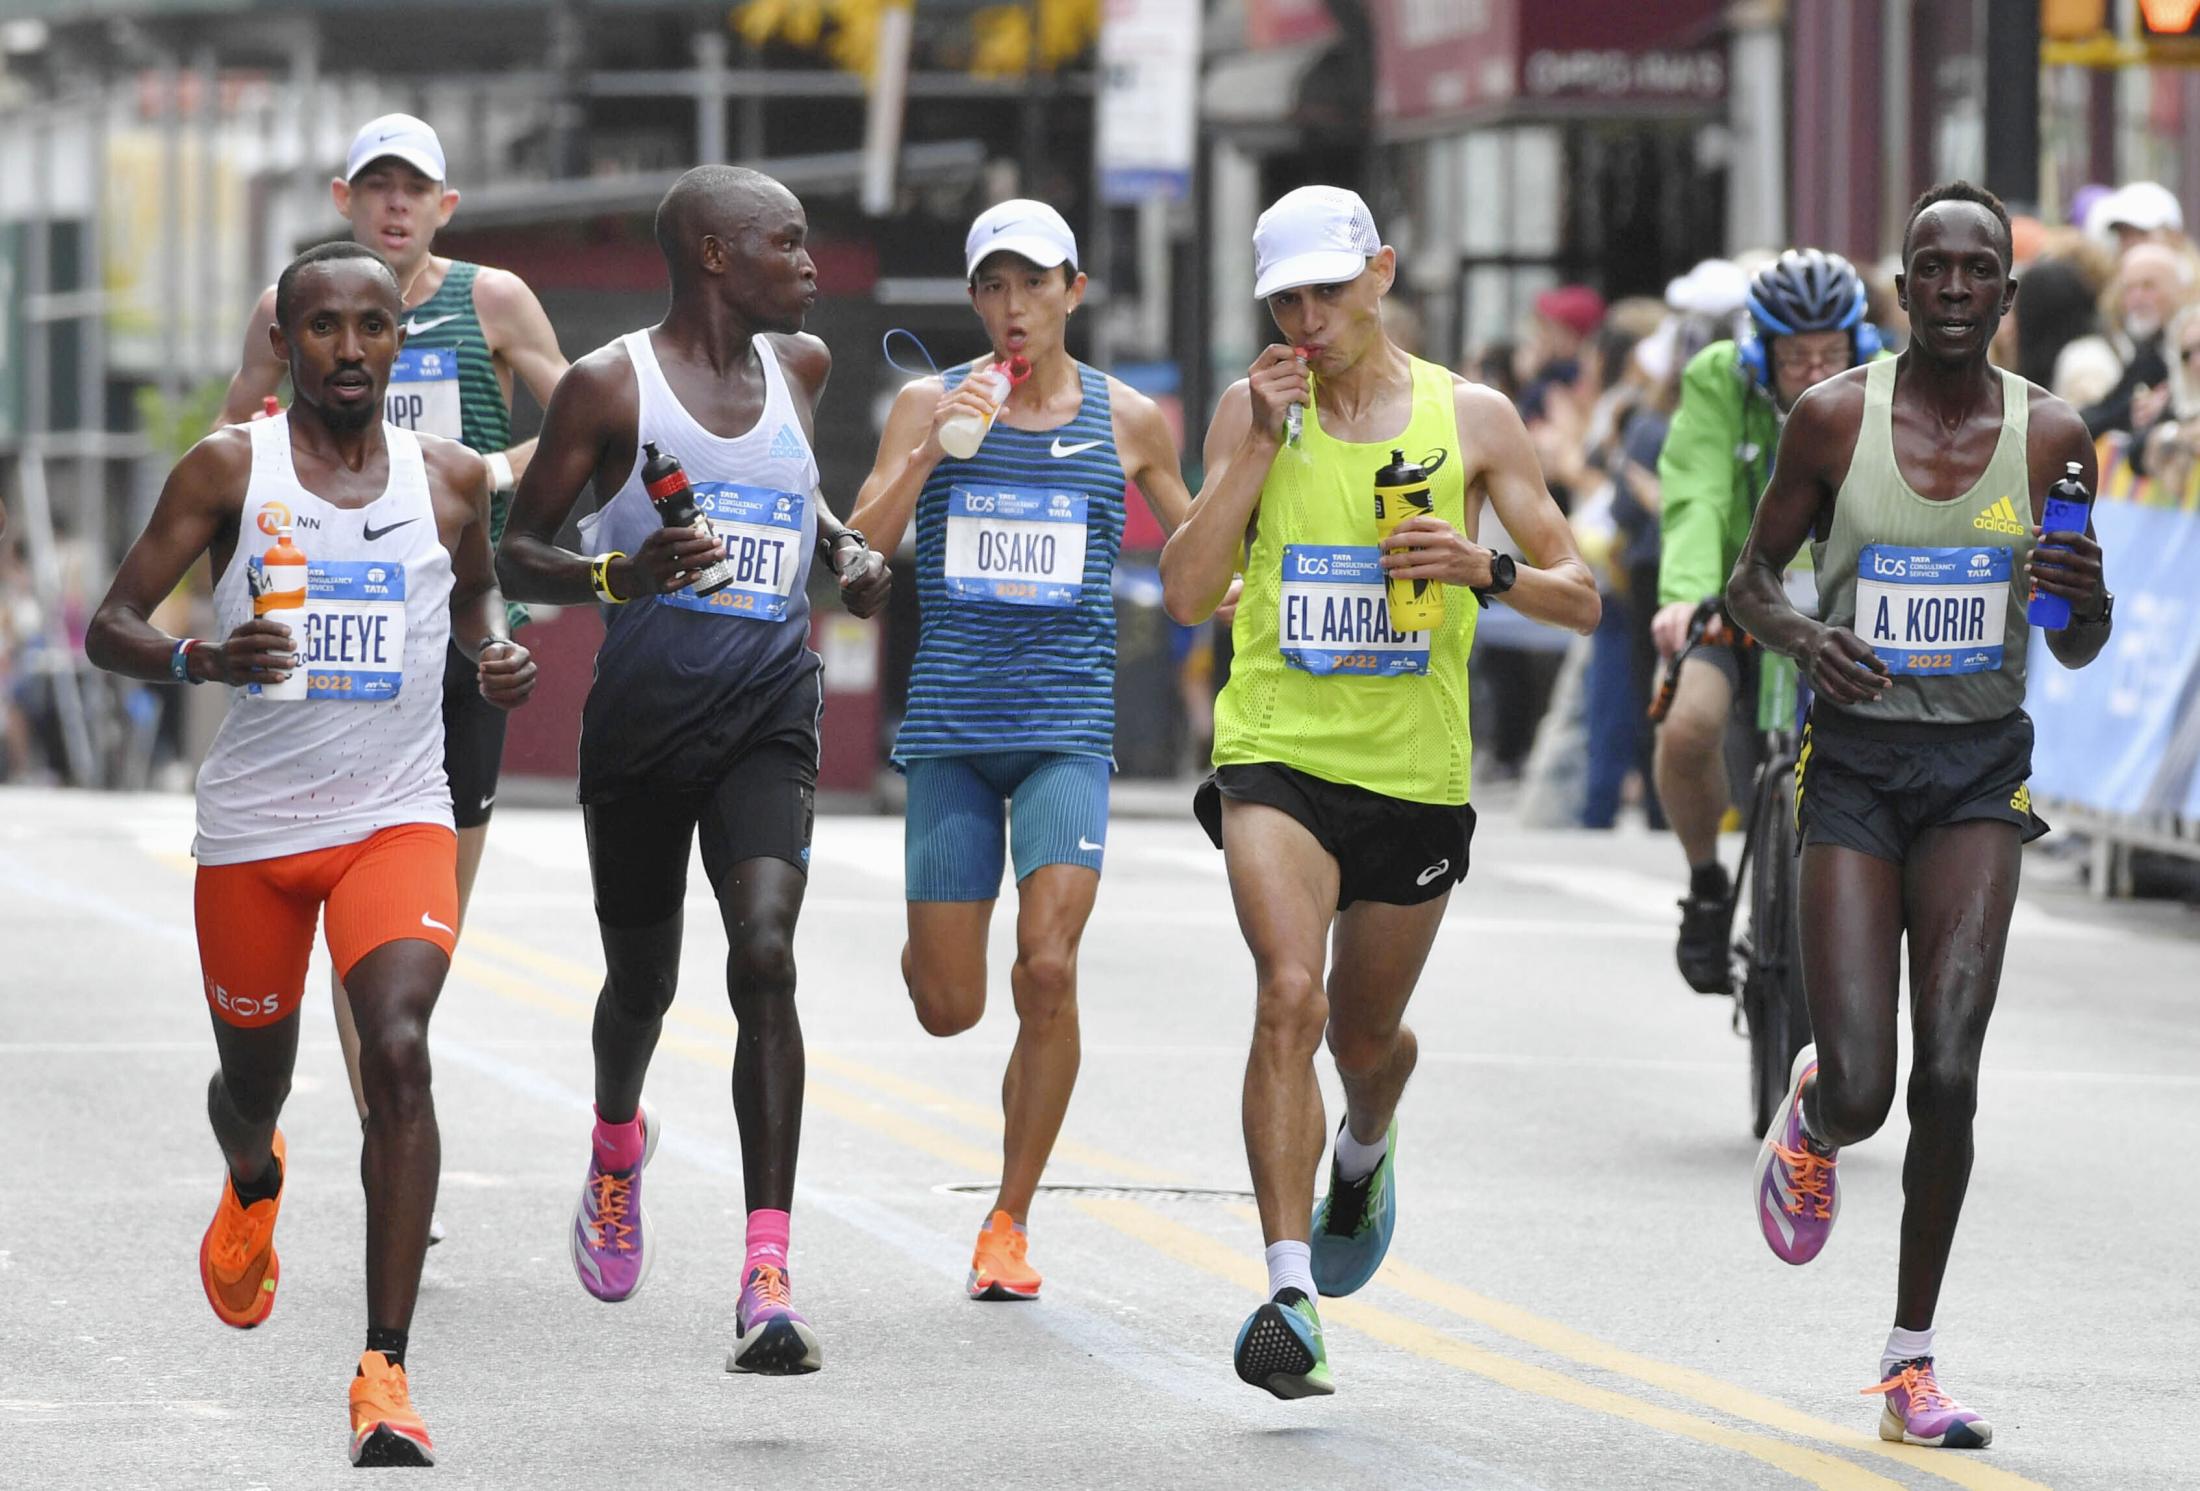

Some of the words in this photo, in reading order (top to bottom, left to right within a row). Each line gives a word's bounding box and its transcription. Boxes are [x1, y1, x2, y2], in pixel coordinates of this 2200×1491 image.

[420, 367, 442, 376] TATA
[693, 491, 716, 511] cs
[720, 490, 739, 499] TATA
[965, 491, 995, 513] tcs
[773, 511, 792, 523] TATA
[1048, 508, 1073, 518] TATA
[297, 515, 321, 530] NN
[1973, 514, 2024, 536] adidas
[978, 530, 1056, 575] OSAKO
[718, 534, 784, 586] EBET
[1297, 553, 1329, 575] tcs
[1331, 561, 1378, 569] CONSULTANCY
[1874, 553, 1906, 577] tcs
[1909, 563, 1956, 571] CONSULTANCY
[308, 569, 325, 577] ATA
[1331, 568, 1361, 576] SERVICES
[1909, 570, 1940, 578] SERVICES
[1967, 569, 1992, 578] TATA
[308, 576, 353, 585] ONSULTANCY
[308, 584, 336, 592] ERVICES
[363, 585, 389, 594] TATA
[708, 591, 755, 610] 2022
[1287, 595, 1313, 642] EL
[1321, 596, 1419, 643] AARA
[1873, 595, 1897, 641] A.
[1906, 597, 1985, 643] KORIR
[307, 613, 388, 663] GEEYE
[1332, 655, 1377, 669] 2022
[1907, 654, 1953, 669] 2022
[204, 974, 279, 1017] NEOS
